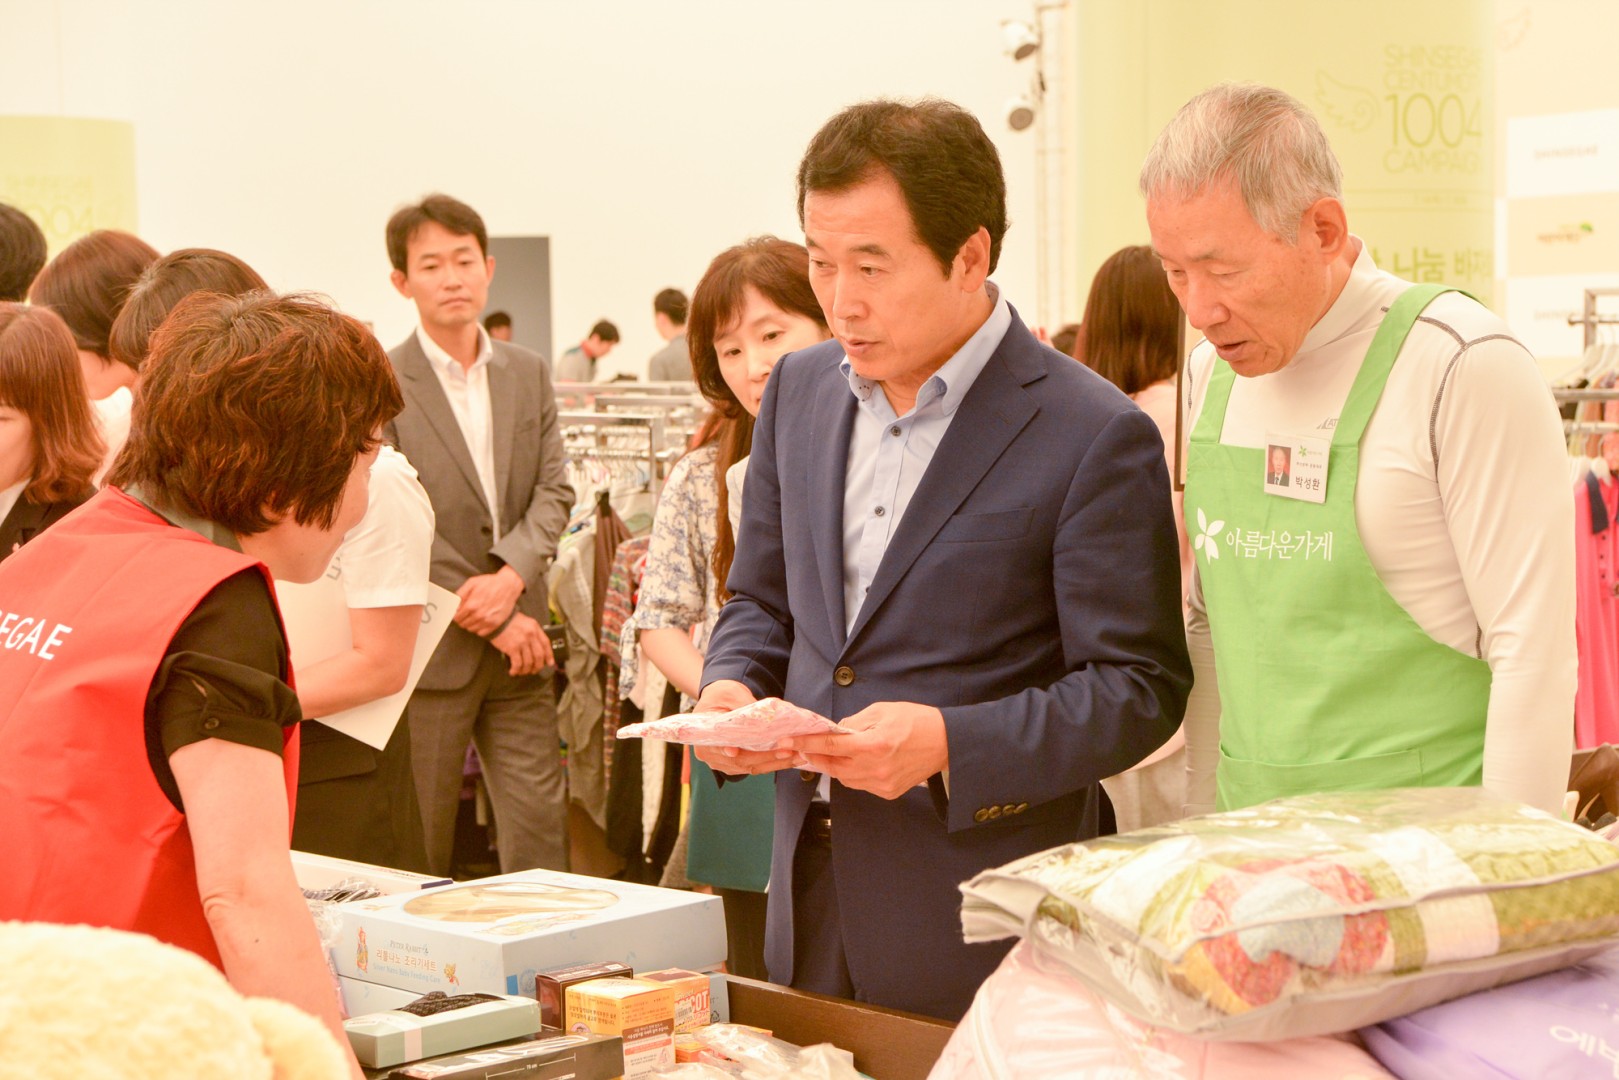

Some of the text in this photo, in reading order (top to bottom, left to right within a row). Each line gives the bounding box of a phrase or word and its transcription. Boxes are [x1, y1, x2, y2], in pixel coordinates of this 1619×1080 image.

[1393, 246, 1446, 282] 나눔
[1295, 475, 1320, 491] 박성환
[1226, 527, 1333, 562] 아름다운가게
[0, 609, 73, 661] EGAE
[403, 954, 437, 972] 조리기세트
